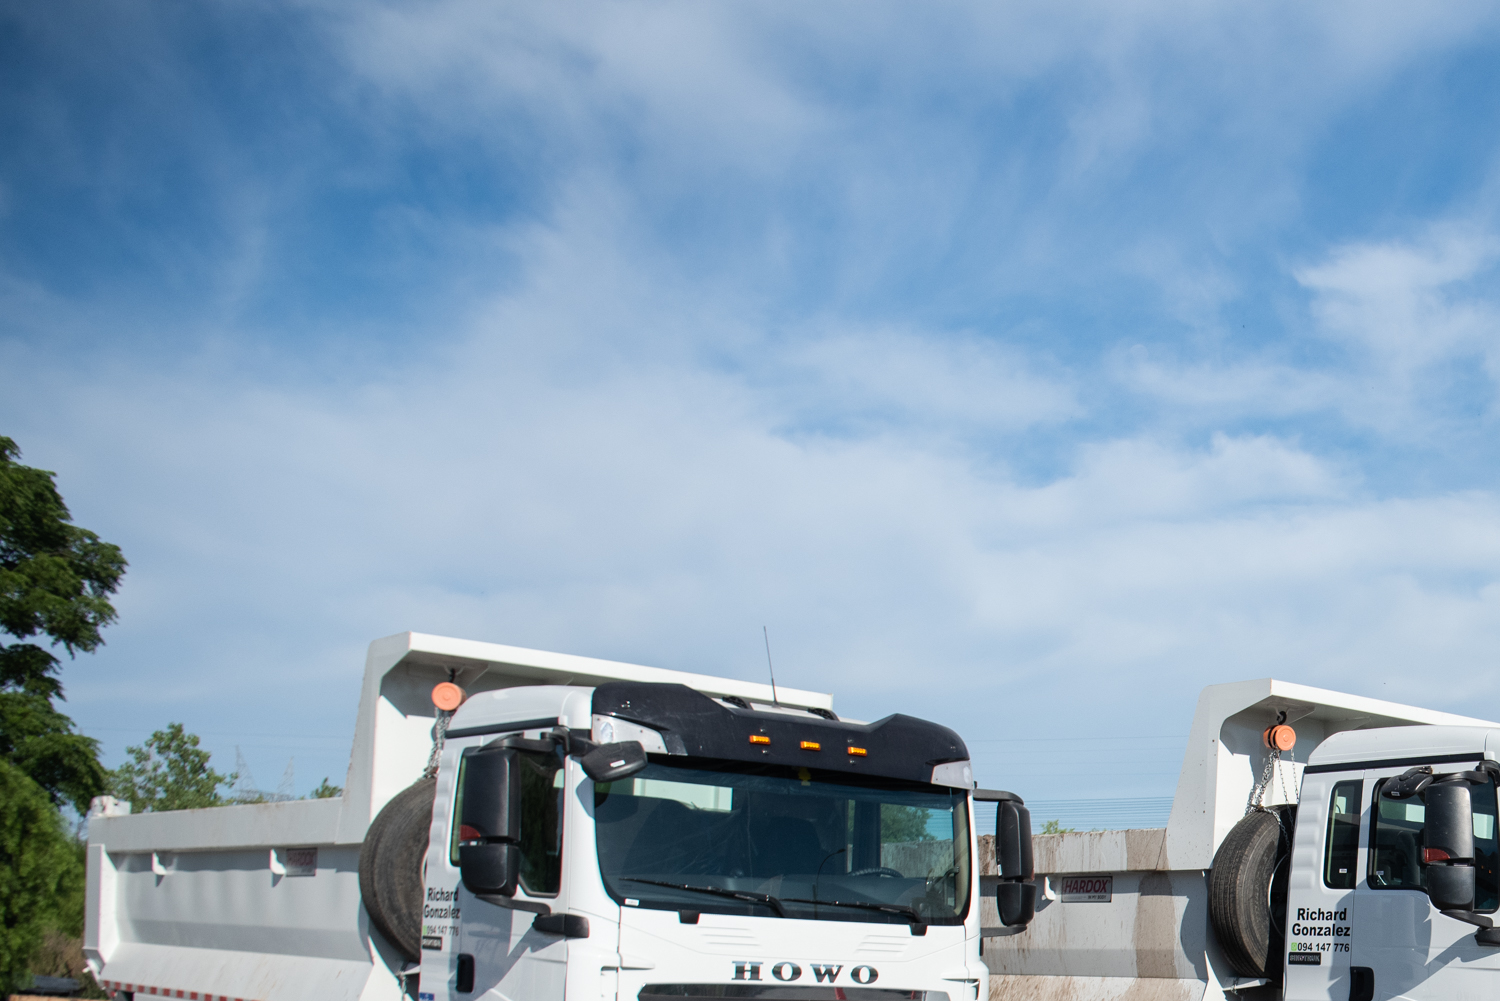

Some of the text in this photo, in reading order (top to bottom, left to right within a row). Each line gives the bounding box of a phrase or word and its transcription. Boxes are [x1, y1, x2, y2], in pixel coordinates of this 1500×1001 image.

[1063, 879, 1109, 893] HARDOX
[427, 887, 459, 901] Richard
[424, 904, 460, 919] Gonzalez
[1297, 907, 1347, 921] Richard
[437, 925, 448, 936] 147
[1292, 923, 1351, 937] Gonzalez
[1297, 942, 1350, 952] 094 147 776
[731, 960, 879, 985] HOWO
